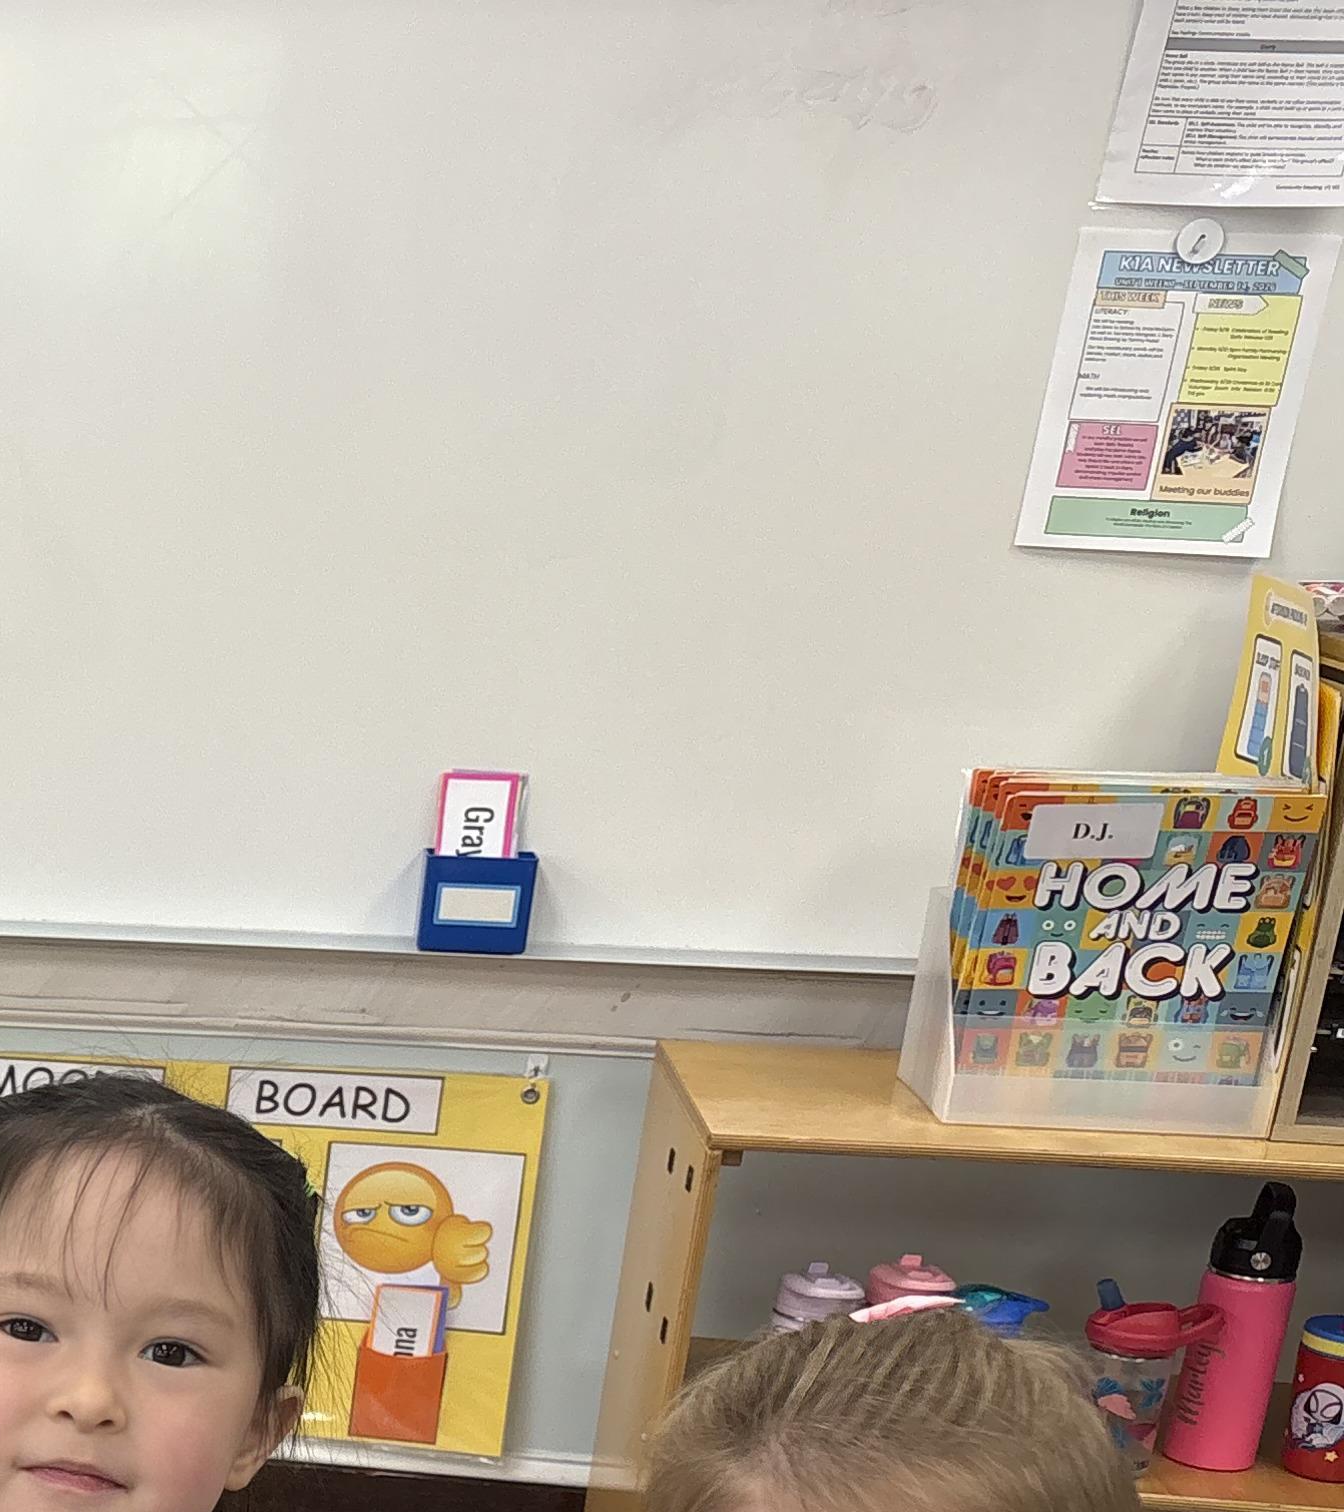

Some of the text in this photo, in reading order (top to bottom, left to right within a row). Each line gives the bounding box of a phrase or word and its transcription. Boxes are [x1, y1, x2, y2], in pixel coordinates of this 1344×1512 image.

[1130, 507, 1170, 519] Religion
[1071, 821, 1115, 841] D.J.
[1034, 861, 1259, 912] HOME
[1089, 910, 1182, 942] AND
[1027, 941, 1236, 1000] BACK
[254, 1079, 412, 1125] BOARD
